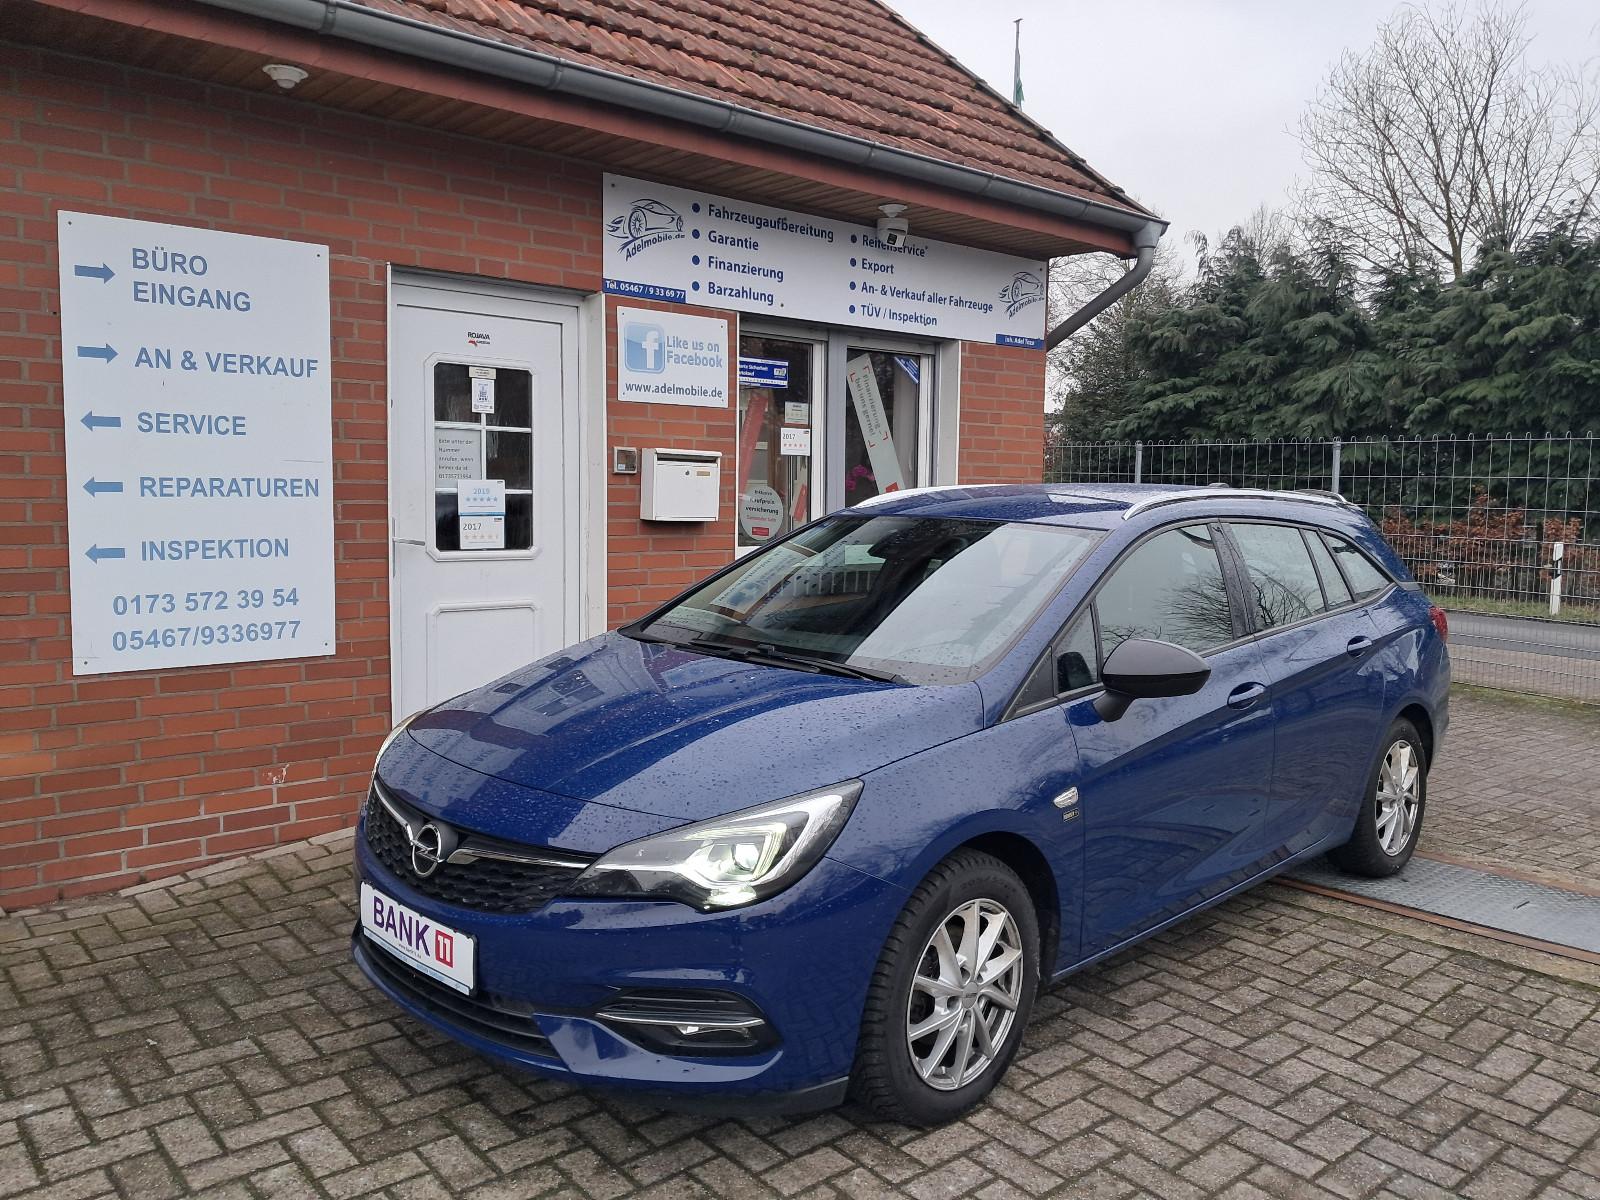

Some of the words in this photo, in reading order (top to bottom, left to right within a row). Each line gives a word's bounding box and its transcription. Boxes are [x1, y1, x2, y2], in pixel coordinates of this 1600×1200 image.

[708, 203, 834, 243] Fahrzeugaufbereitung
[625, 233, 686, 262] Adelmobile.de
[708, 230, 759, 250] Garantie
[131, 246, 208, 277] BÜRO
[708, 255, 784, 283] Finanzierung
[861, 258, 895, 275] Export
[133, 281, 251, 312] EINGANG
[605, 280, 619, 289] Tel.
[620, 282, 643, 293] 05467
[649, 286, 654, 294] 9
[655, 287, 664, 296] 33
[665, 289, 675, 298] 69
[676, 290, 685, 299] 77
[708, 281, 774, 306] Barzahlung
[861, 281, 879, 294] An-
[880, 284, 888, 296] &
[889, 285, 926, 301] Verkauf
[927, 292, 947, 305] aller
[948, 295, 994, 314] Fahrzeuge
[861, 303, 882, 318] TÜV
[888, 308, 938, 326] Inspektion
[666, 335, 689, 350] Like
[692, 340, 704, 351] us
[707, 342, 720, 353] on
[135, 347, 172, 370] AN
[180, 349, 198, 371] &
[205, 351, 319, 379] VERKAUF
[666, 350, 723, 368] Facebook
[625, 382, 723, 399] www.adelmobile.de
[137, 411, 247, 437] SERVICE
[139, 477, 320, 498] REPARATUREN
[462, 523, 482, 531] 2017
[140, 537, 290, 562] INSPEKTION
[112, 593, 176, 617] 0173
[185, 590, 228, 613] 572
[236, 588, 265, 610] 39
[271, 586, 300, 607] 54
[112, 620, 301, 652] 05467/9336977
[373, 895, 431, 957] BANK
